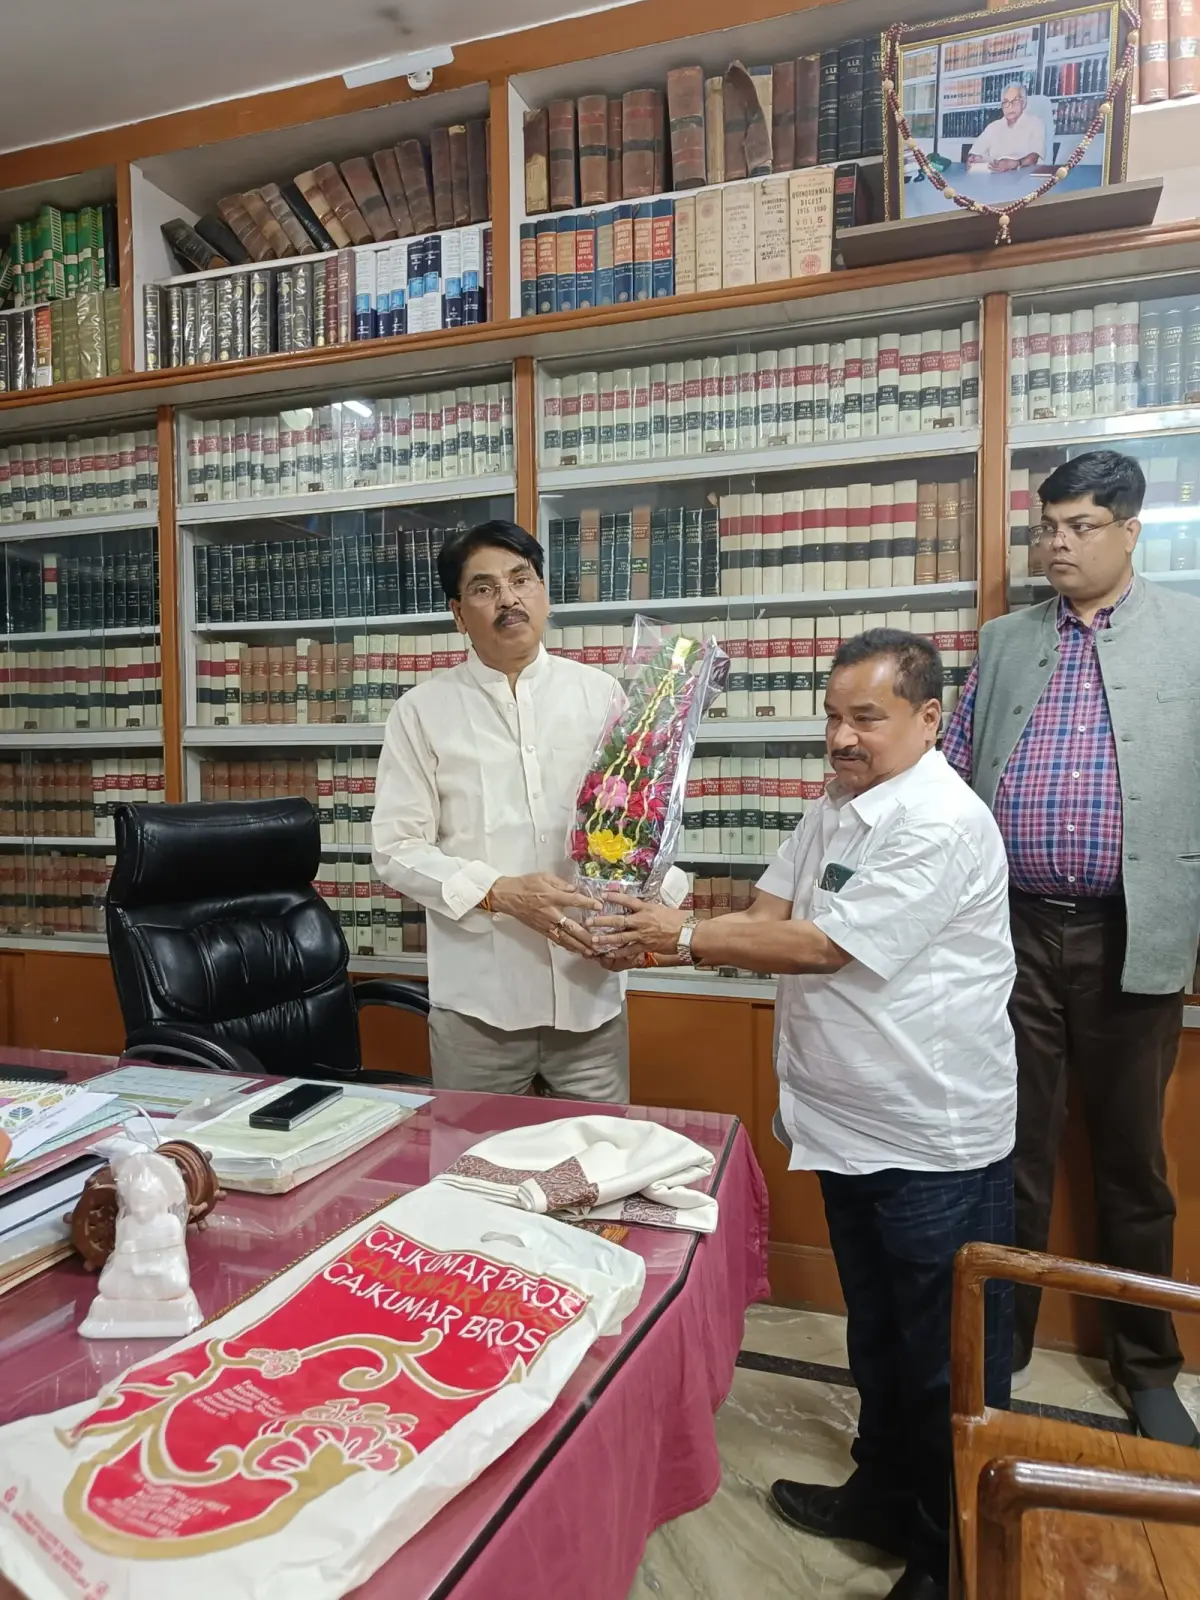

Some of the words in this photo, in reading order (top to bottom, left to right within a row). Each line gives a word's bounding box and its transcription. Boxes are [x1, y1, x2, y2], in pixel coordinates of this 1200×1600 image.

[800, 197, 822, 206] DIGEST
[323, 1262, 463, 1335] GAJKUMAR
[459, 1315, 547, 1352] BROS
[364, 1229, 499, 1292] GAJKUMAR
[497, 1269, 588, 1319] BROS
